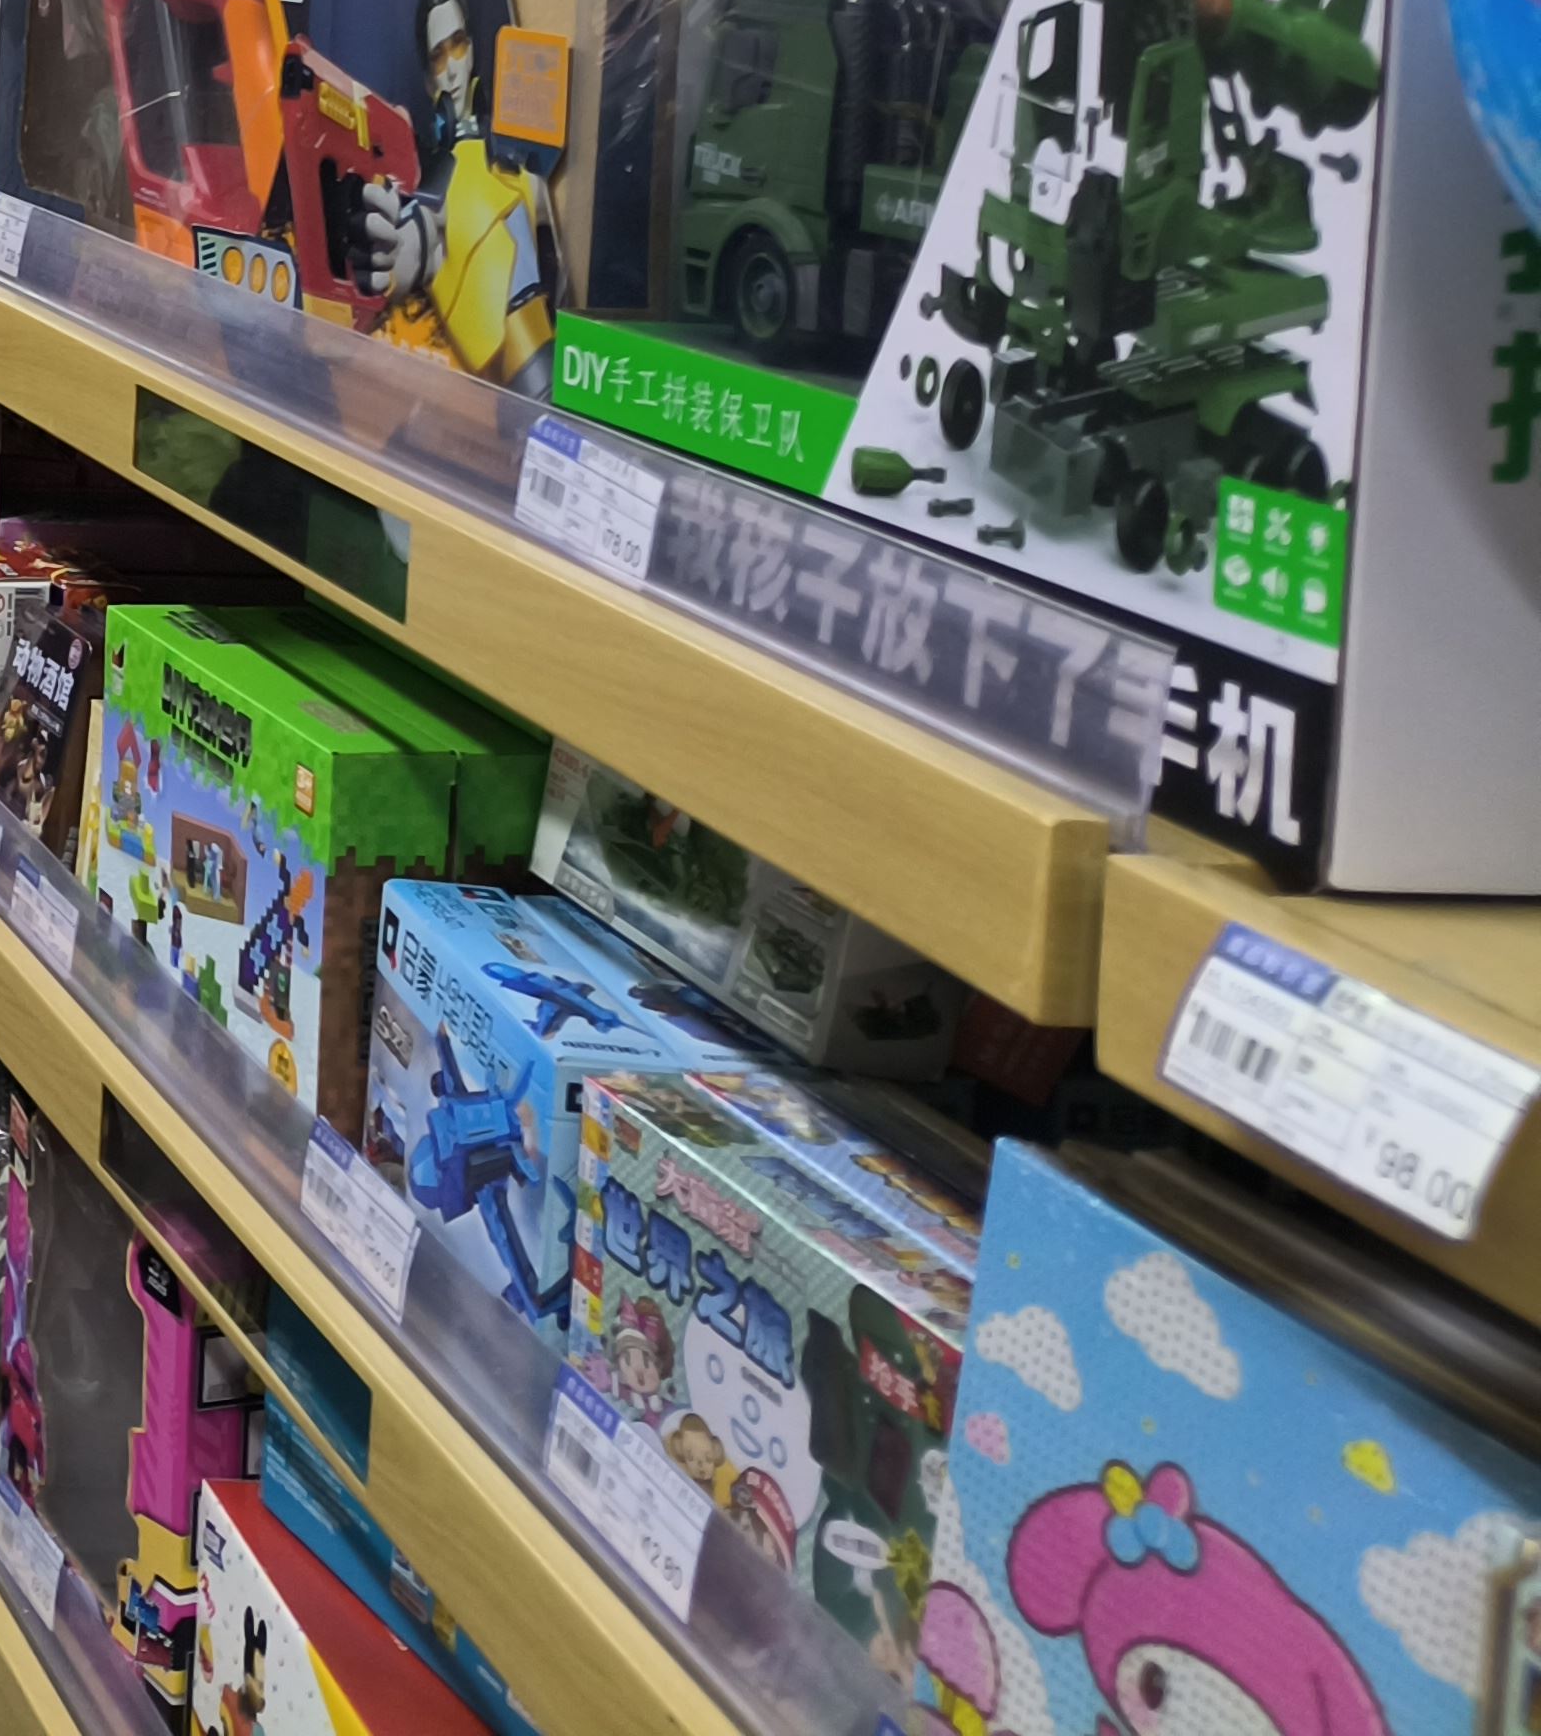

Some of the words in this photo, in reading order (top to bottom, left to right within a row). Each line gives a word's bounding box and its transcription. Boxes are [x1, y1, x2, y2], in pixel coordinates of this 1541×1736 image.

[561, 344, 805, 465] DIY手工拼装保卫队
[12, 636, 76, 712] 动物酒馆
[600, 1175, 797, 1391] 世界之旅
